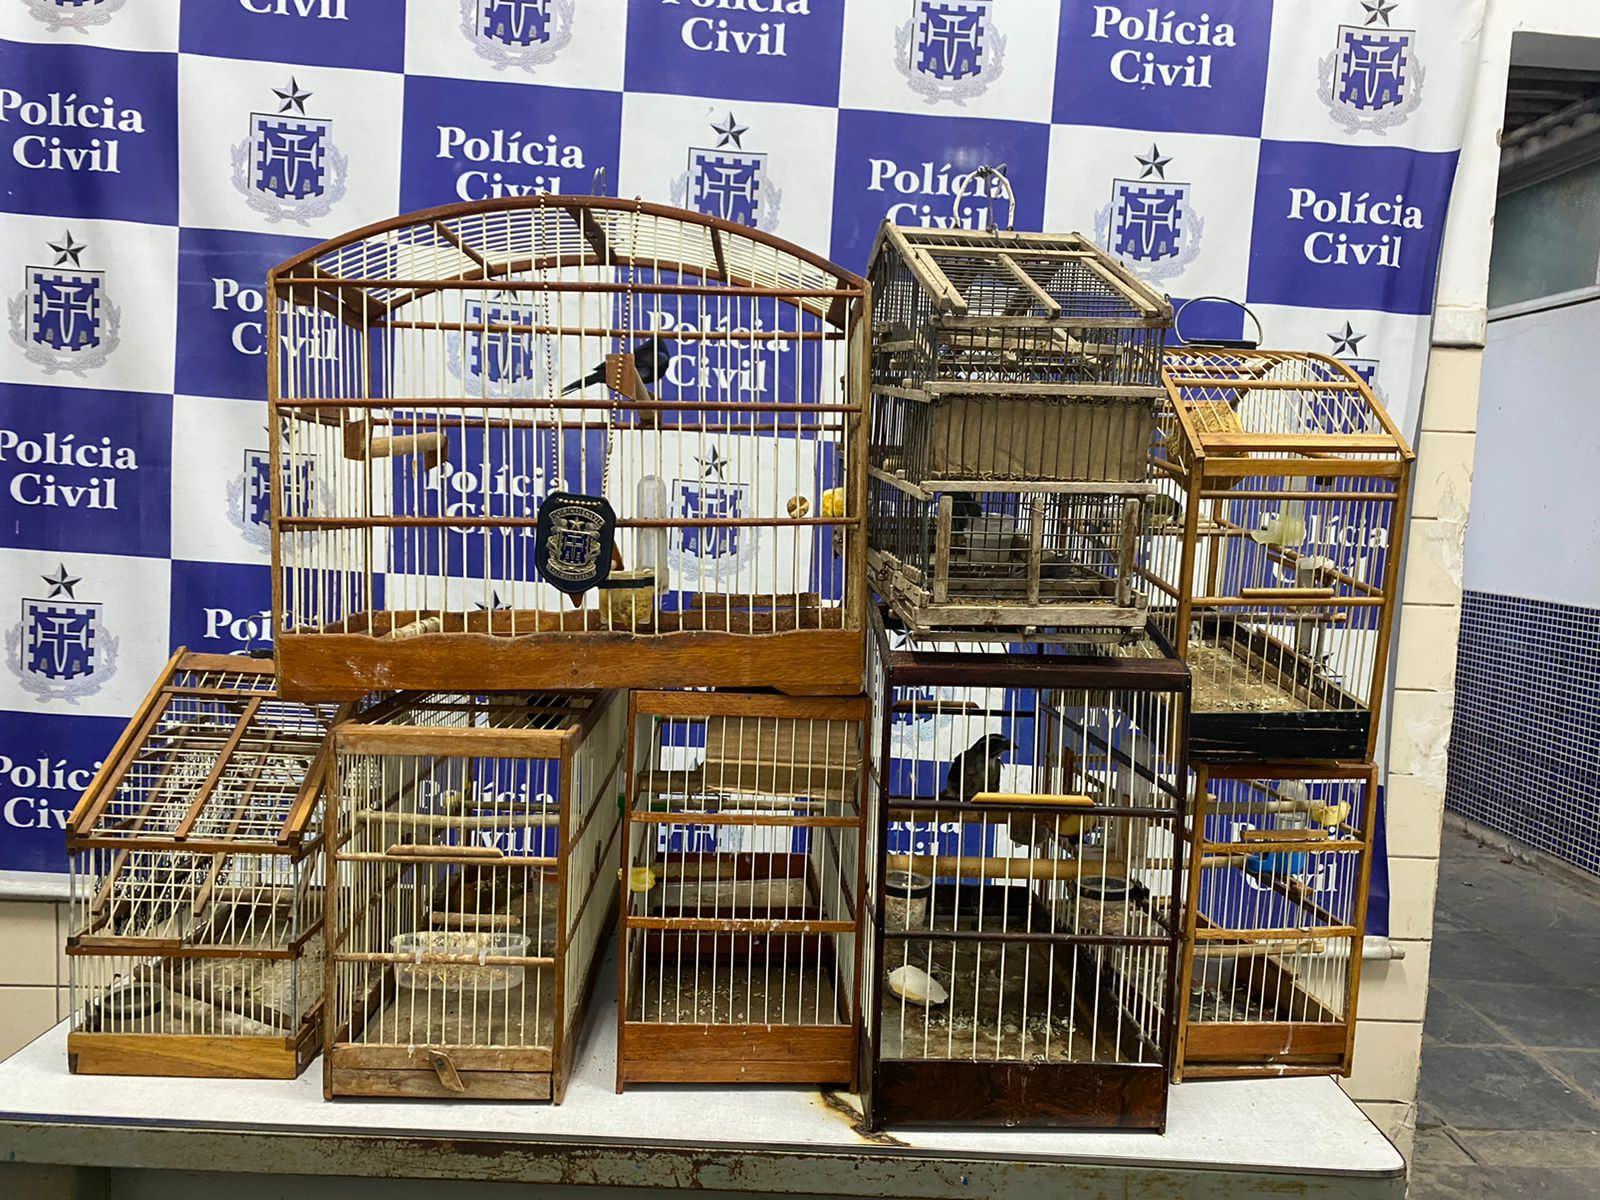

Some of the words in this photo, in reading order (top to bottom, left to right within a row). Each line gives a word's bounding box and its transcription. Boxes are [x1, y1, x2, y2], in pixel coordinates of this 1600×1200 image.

[681, 17, 787, 56] Civil
[1091, 5, 1236, 47] Polícia
[1110, 49, 1212, 88] Civil
[0, 89, 146, 133] Polícia
[13, 135, 120, 173] Civil
[436, 126, 585, 169] Polícia
[867, 159, 1010, 199] Polícia
[1287, 187, 1424, 229] Polícia
[1303, 231, 1402, 268] Civil
[232, 322, 338, 360] Cvil
[665, 355, 768, 392] Civil
[10, 473, 118, 510] Civil
